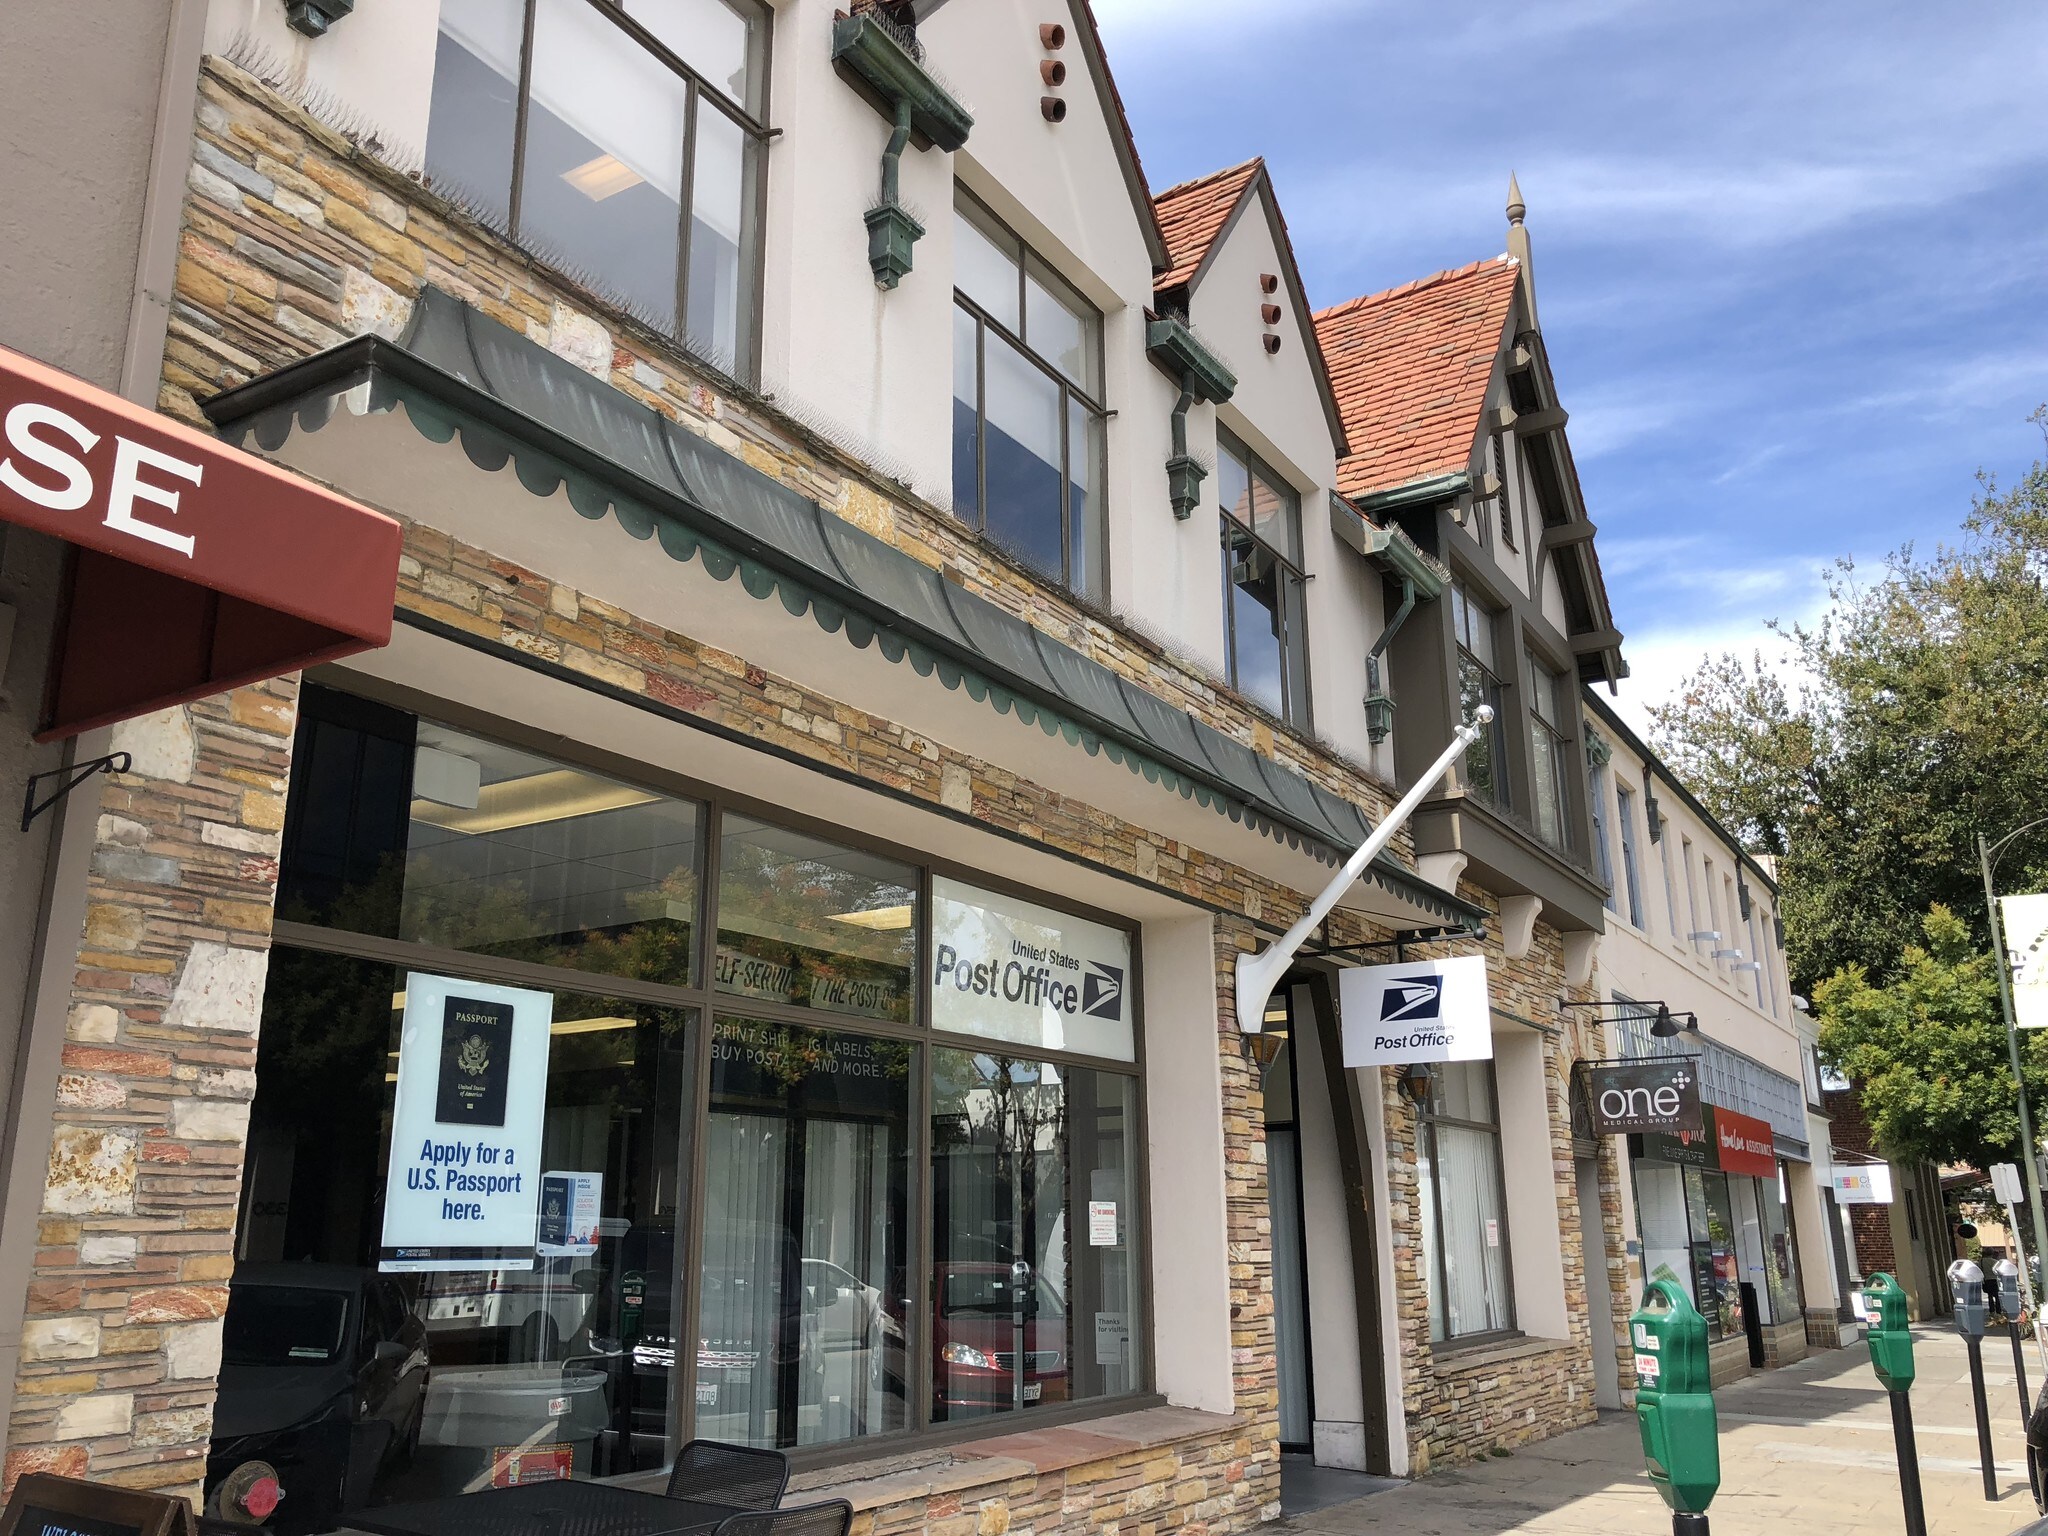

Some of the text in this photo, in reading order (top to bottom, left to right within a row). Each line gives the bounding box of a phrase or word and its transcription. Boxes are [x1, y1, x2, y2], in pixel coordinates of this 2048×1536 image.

[1012, 939, 1080, 971] United States
[823, 977, 848, 1004] THE
[848, 982, 882, 1009] POST
[934, 943, 1078, 1014] Post Office
[455, 1011, 499, 1026] PASSPORT
[1414, 1025, 1435, 1033] United
[712, 1022, 756, 1043] PRINT
[825, 1039, 875, 1061] LABELS,
[1374, 1032, 1455, 1050] Post Office
[711, 1043, 742, 1061] BUY
[812, 1057, 839, 1074] AND
[842, 1061, 883, 1078] MORE.
[1600, 1086, 1680, 1119] one
[419, 1139, 514, 1168] Apply for a
[407, 1167, 522, 1194] U.S. Passport
[442, 1197, 485, 1221] here.
